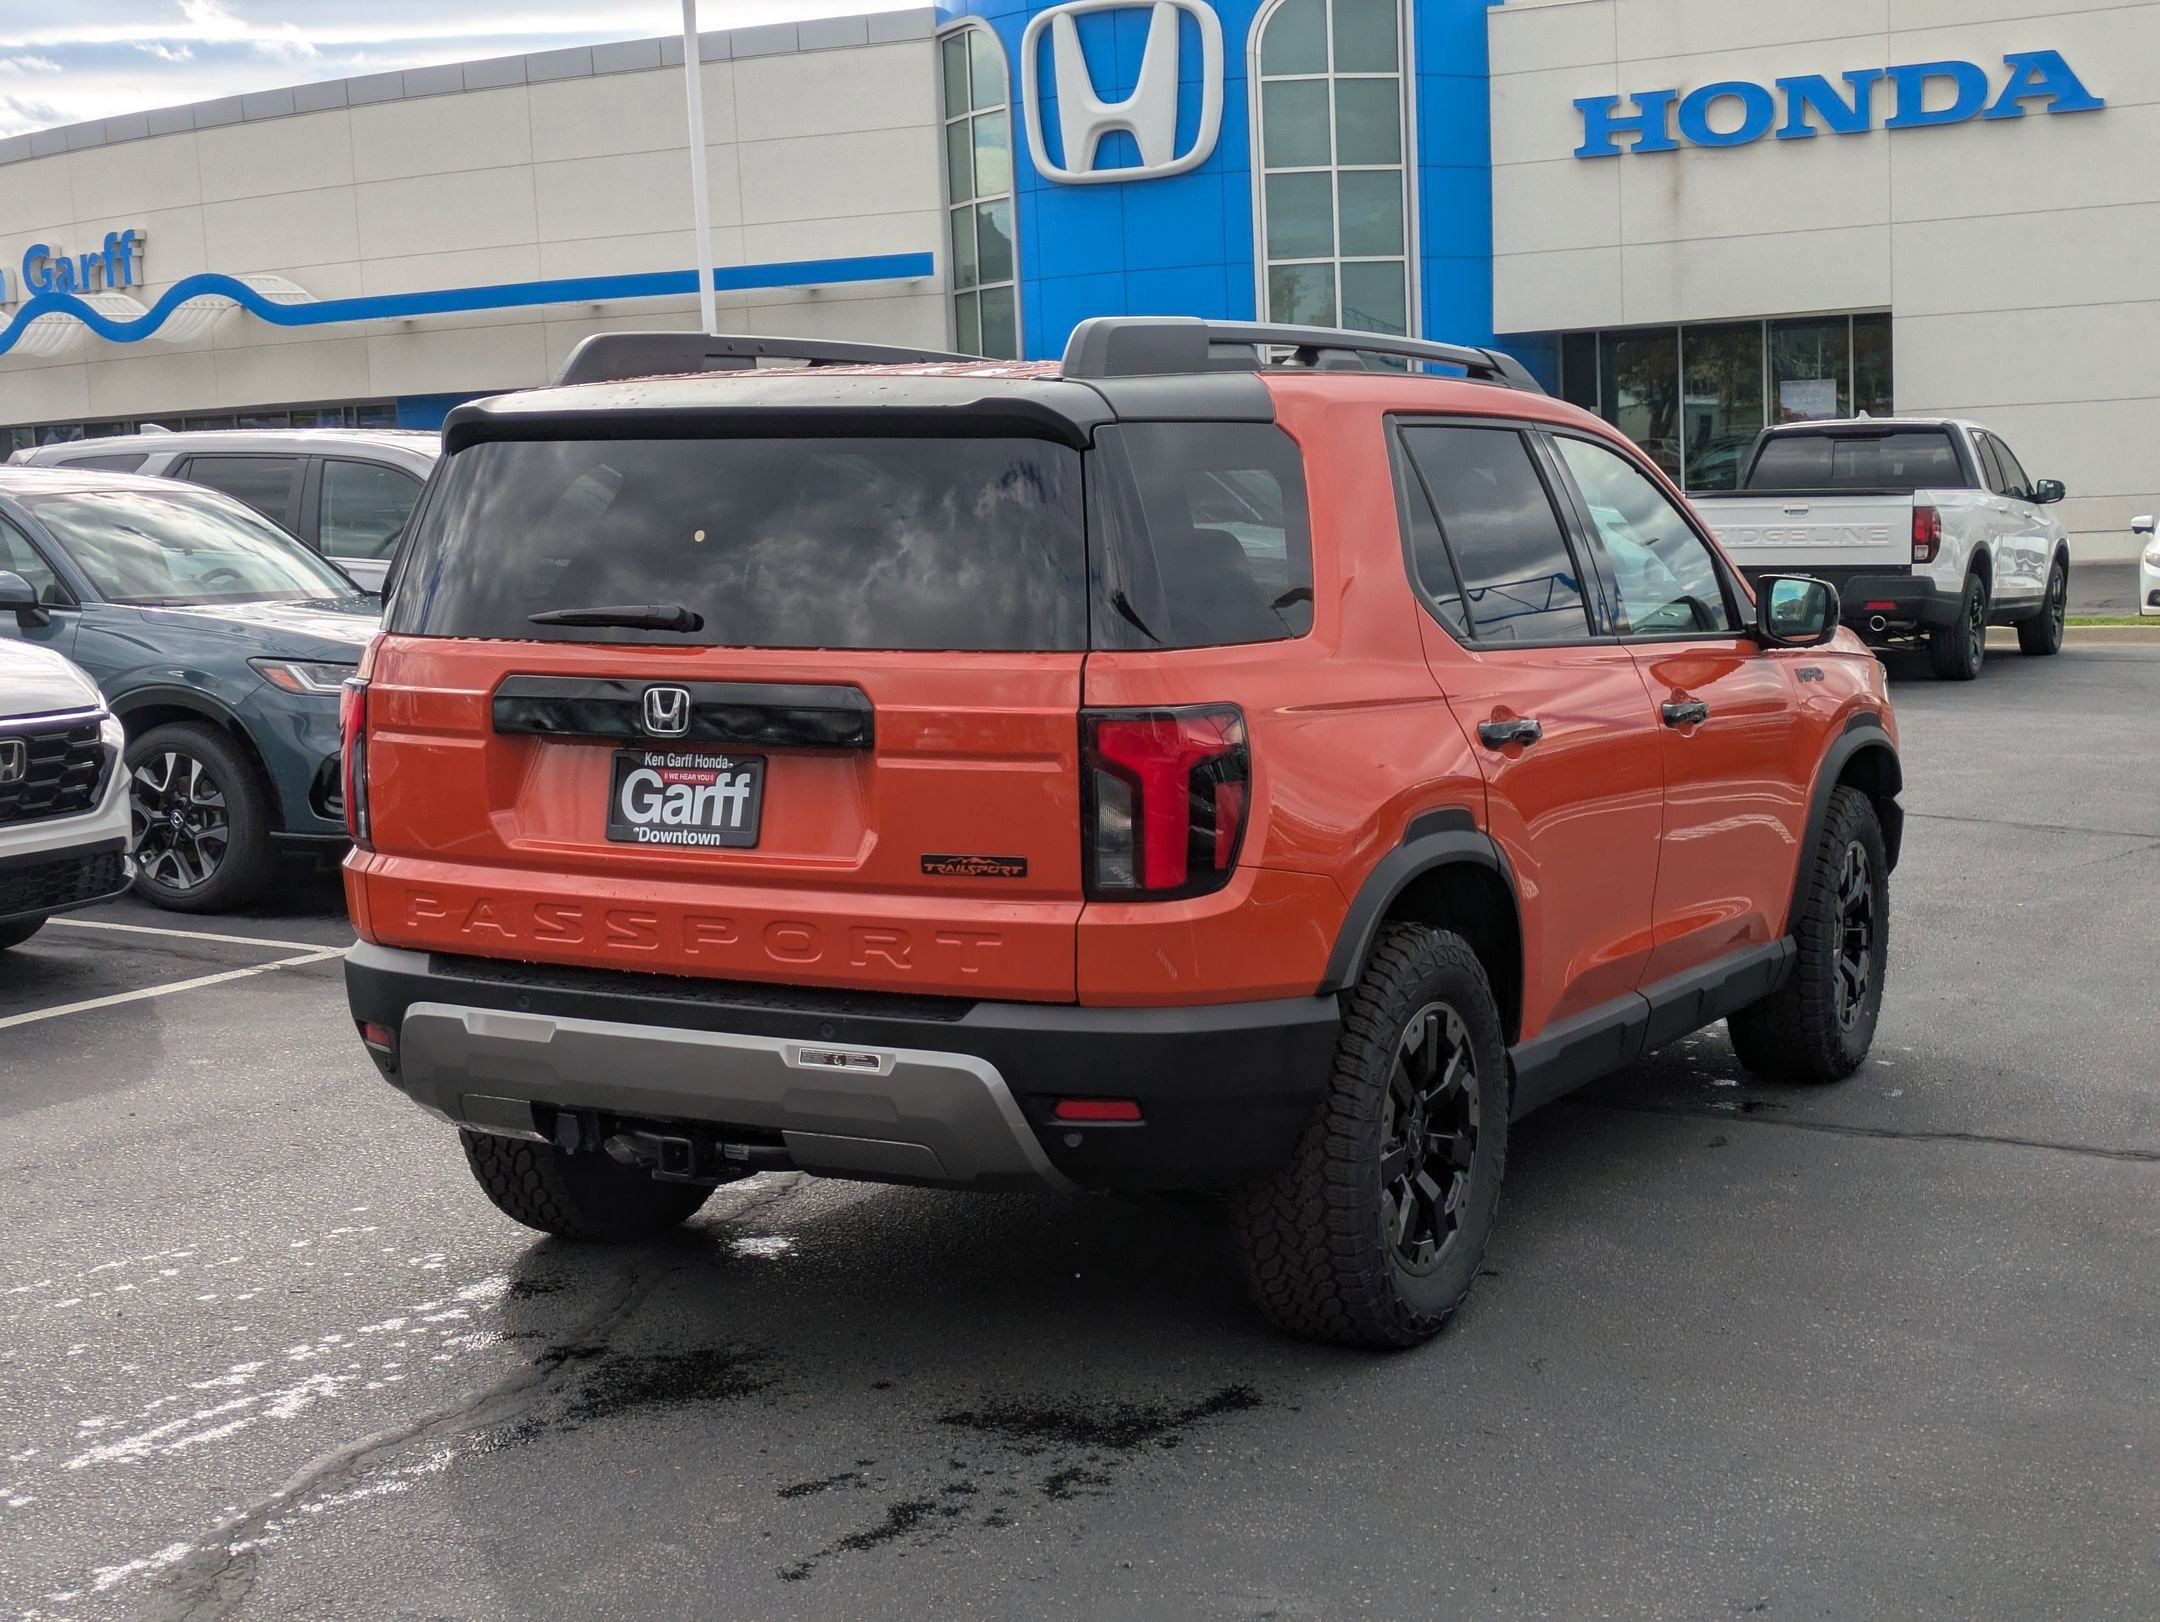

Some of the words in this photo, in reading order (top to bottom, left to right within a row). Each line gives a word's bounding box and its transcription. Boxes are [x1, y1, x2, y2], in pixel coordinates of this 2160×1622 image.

[1573, 49, 2104, 159] HONDA
[22, 229, 146, 298] Garff
[644, 752, 664, 767] Ken
[667, 753, 693, 768] Garff
[695, 754, 729, 769] Honda
[621, 768, 750, 827] Garff
[638, 827, 720, 846] Downtown
[924, 863, 1024, 876] TRAILSPORT
[405, 889, 1004, 973] PASSPORT
